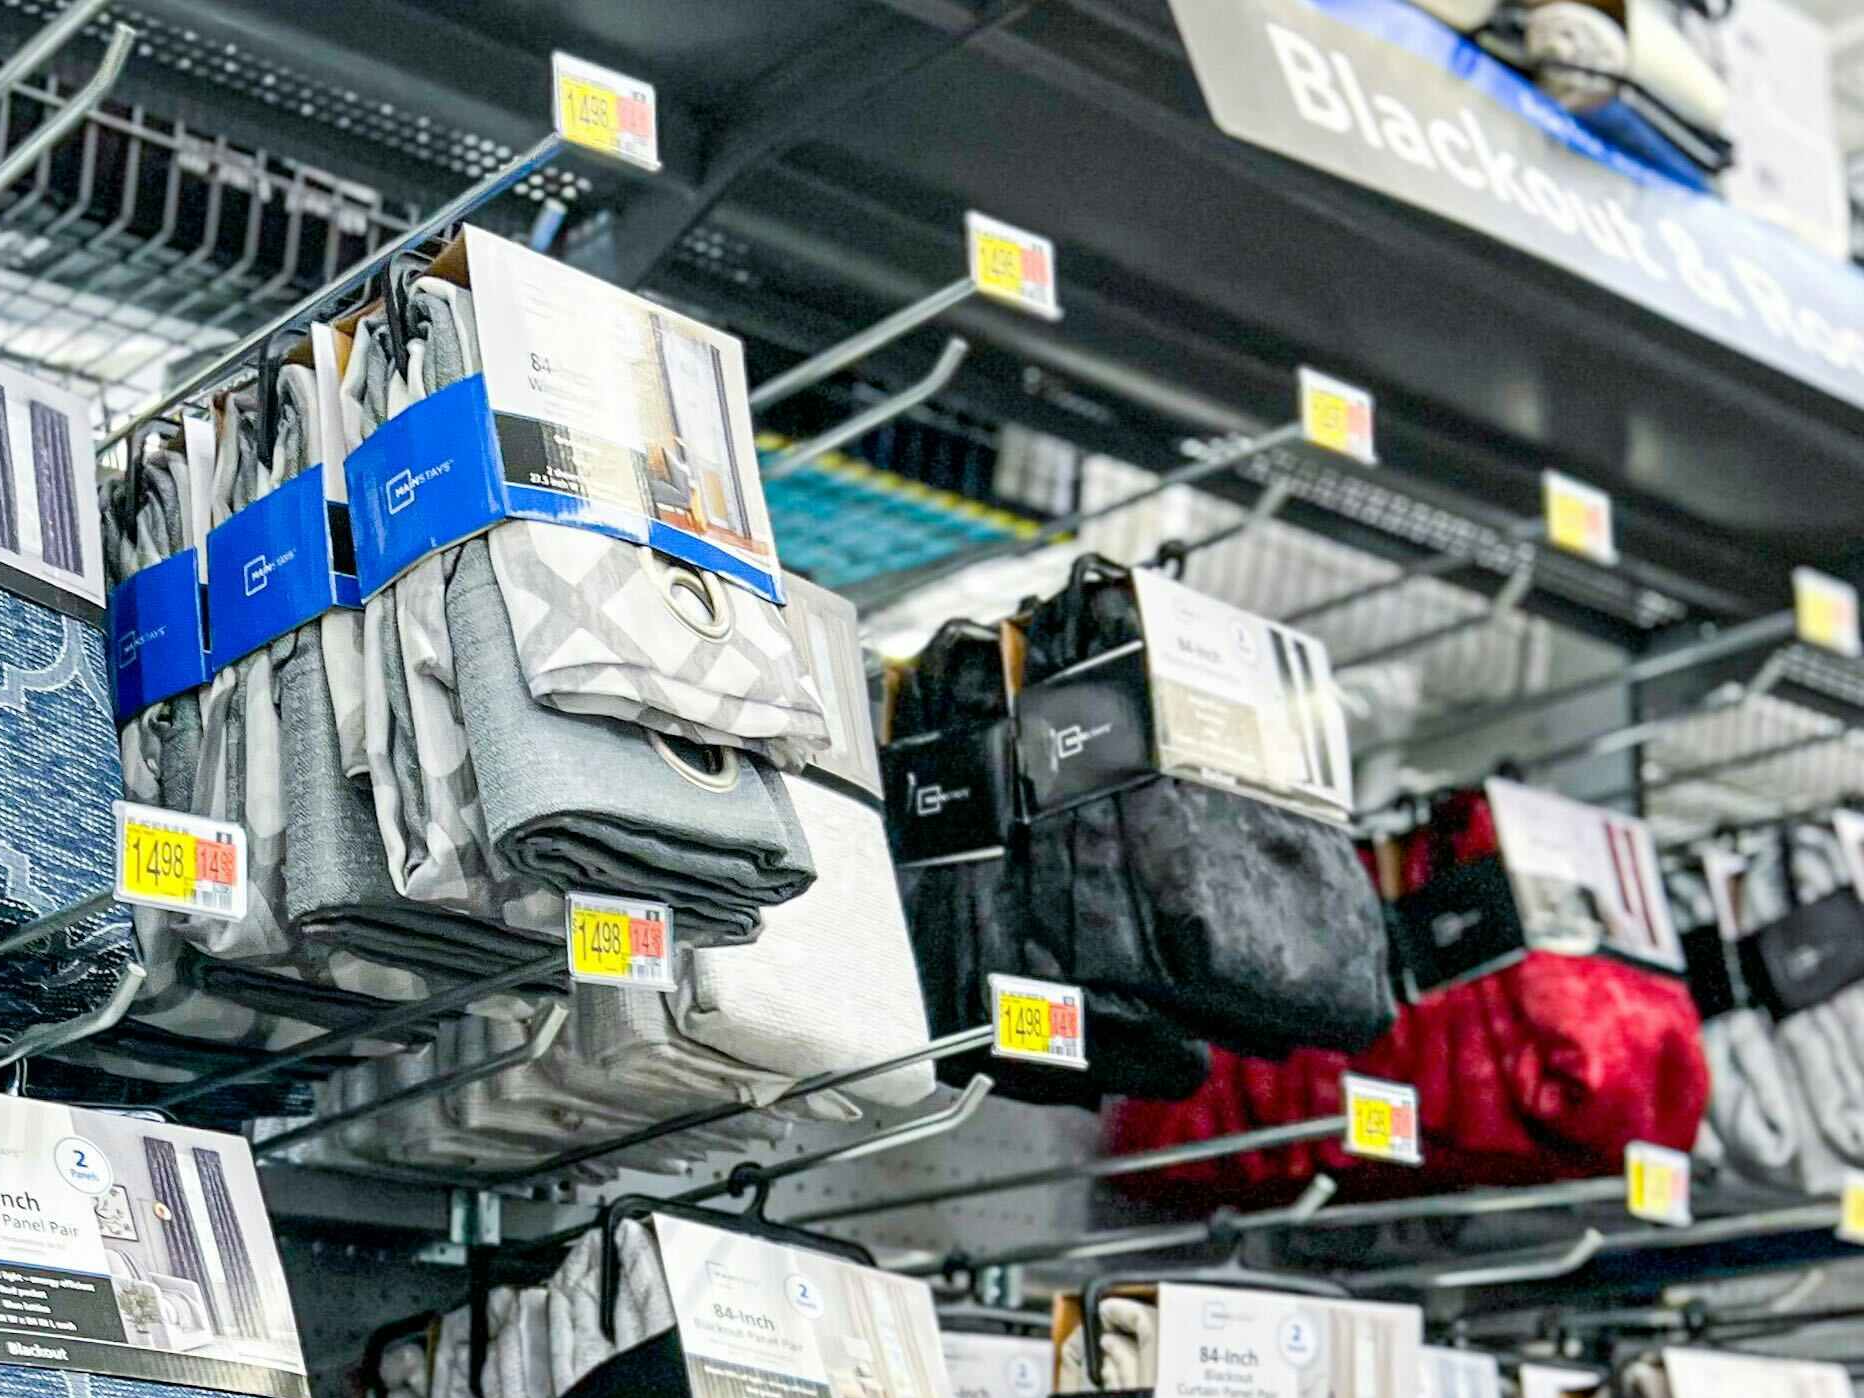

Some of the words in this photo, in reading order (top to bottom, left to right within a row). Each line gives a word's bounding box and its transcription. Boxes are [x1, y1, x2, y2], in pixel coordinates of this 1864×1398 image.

[1267, 22, 1668, 279] Blackout
[395, 459, 454, 499] MAINSTAYS
[73, 1149, 88, 1168] 2
[3, 1213, 45, 1232] Panel
[49, 1221, 79, 1237] Pair
[799, 1284, 808, 1298] 2
[713, 1303, 775, 1331] 84-Inch
[6, 1341, 69, 1361] Blackout
[1199, 1346, 1259, 1366] 84-Inch
